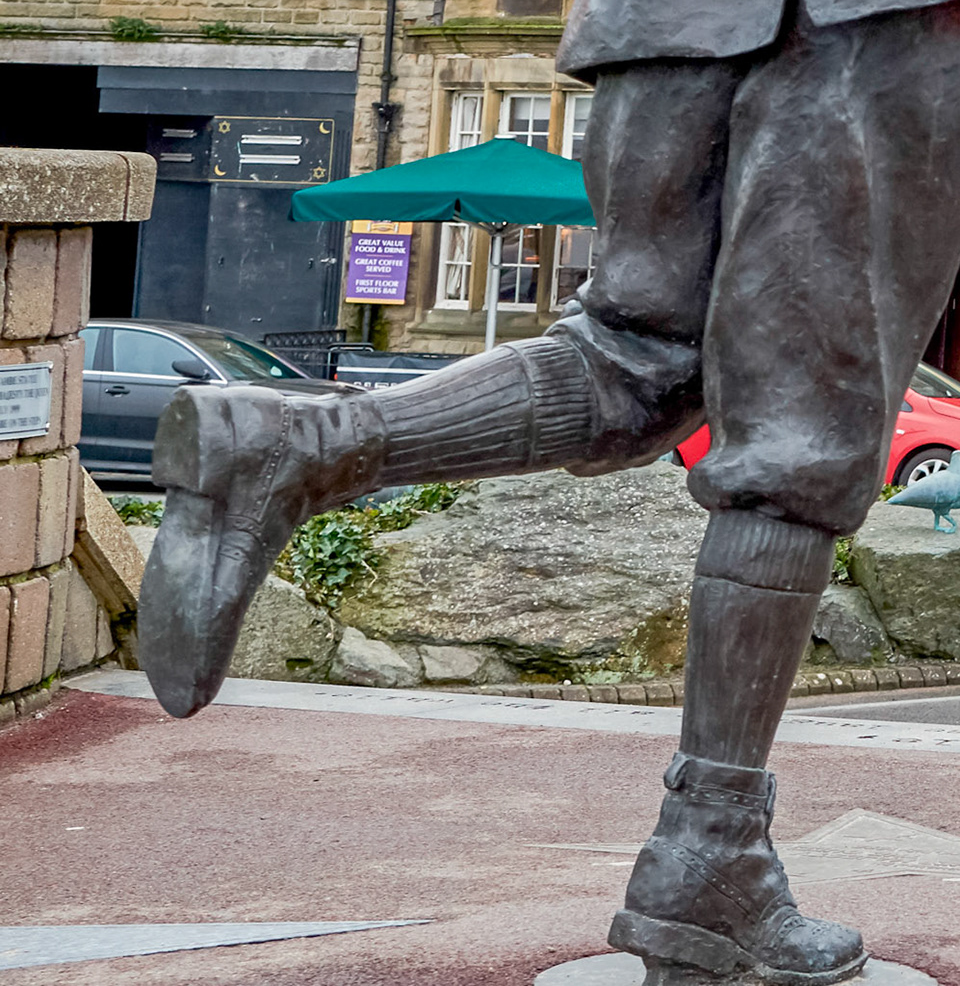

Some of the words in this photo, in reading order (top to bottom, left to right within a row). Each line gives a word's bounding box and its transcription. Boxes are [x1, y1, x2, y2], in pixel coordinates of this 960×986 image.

[355, 245, 376, 253] FOOD
[378, 259, 403, 267] COFFEE
[365, 265, 392, 273] SERVED
[374, 280, 399, 288] FLOOR
[355, 286, 381, 294] SPORTS
[382, 287, 397, 295] BAR
